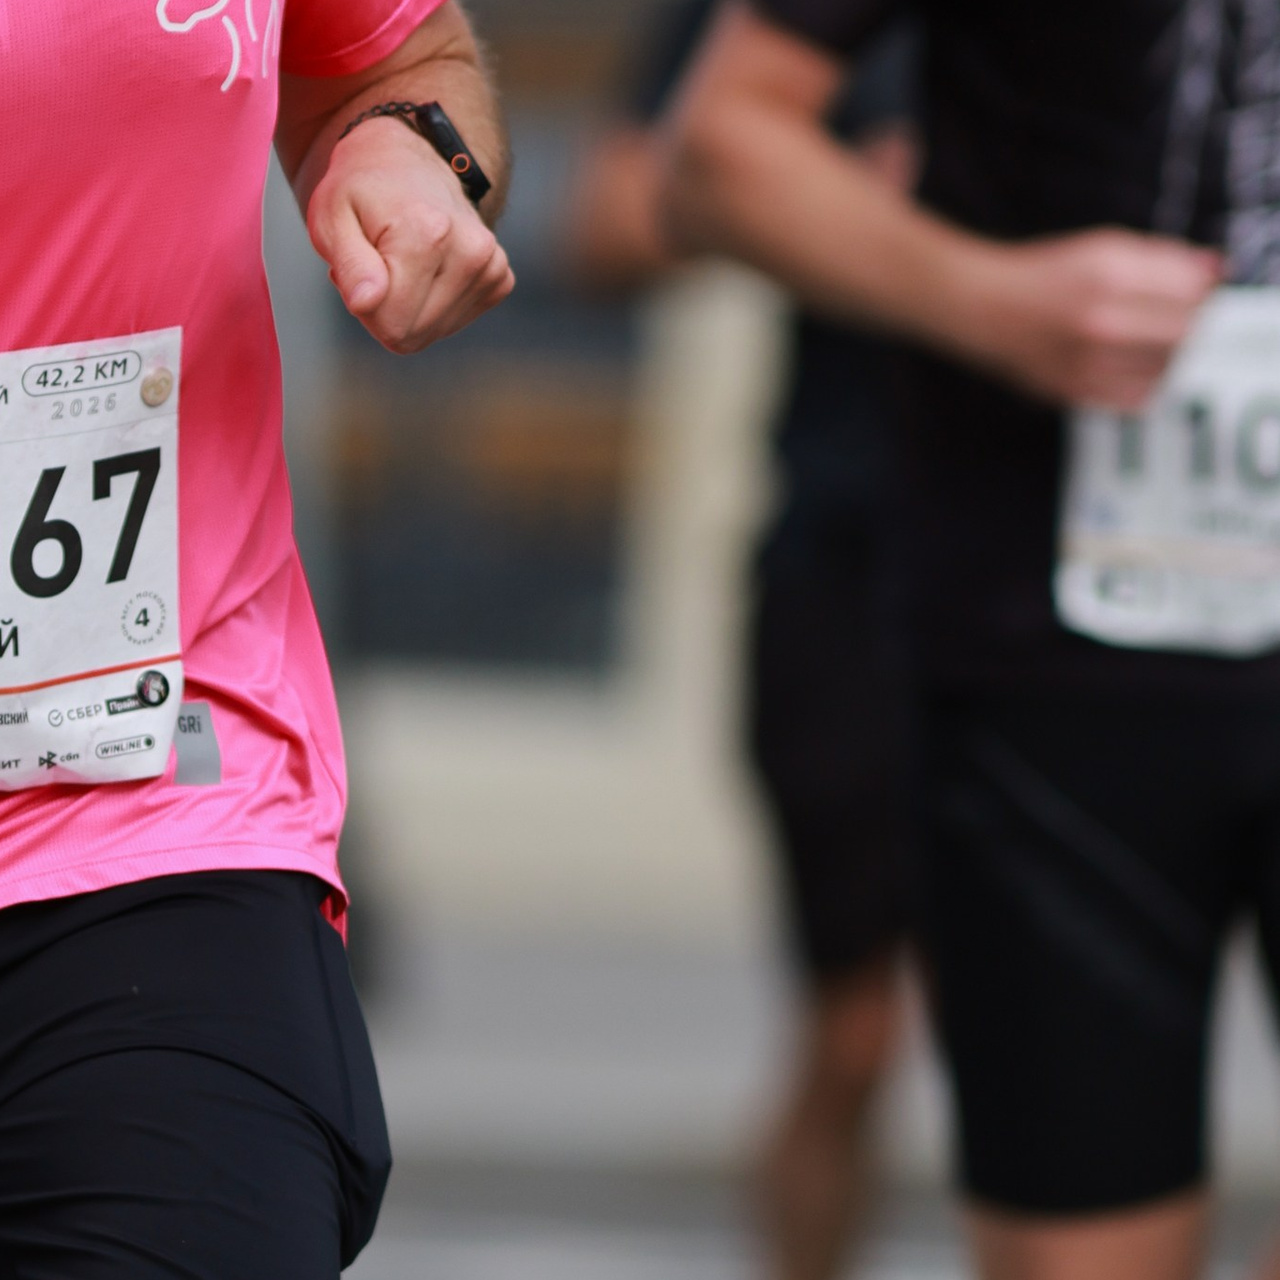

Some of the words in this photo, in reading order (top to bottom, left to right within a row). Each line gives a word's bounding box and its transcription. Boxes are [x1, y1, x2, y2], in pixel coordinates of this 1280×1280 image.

[36, 365, 85, 388] 42,2
[51, 393, 117, 420] 2026
[134, 607, 151, 628] 4
[66, 704, 103, 721] СБЕР
[100, 739, 142, 755] WINLINE
